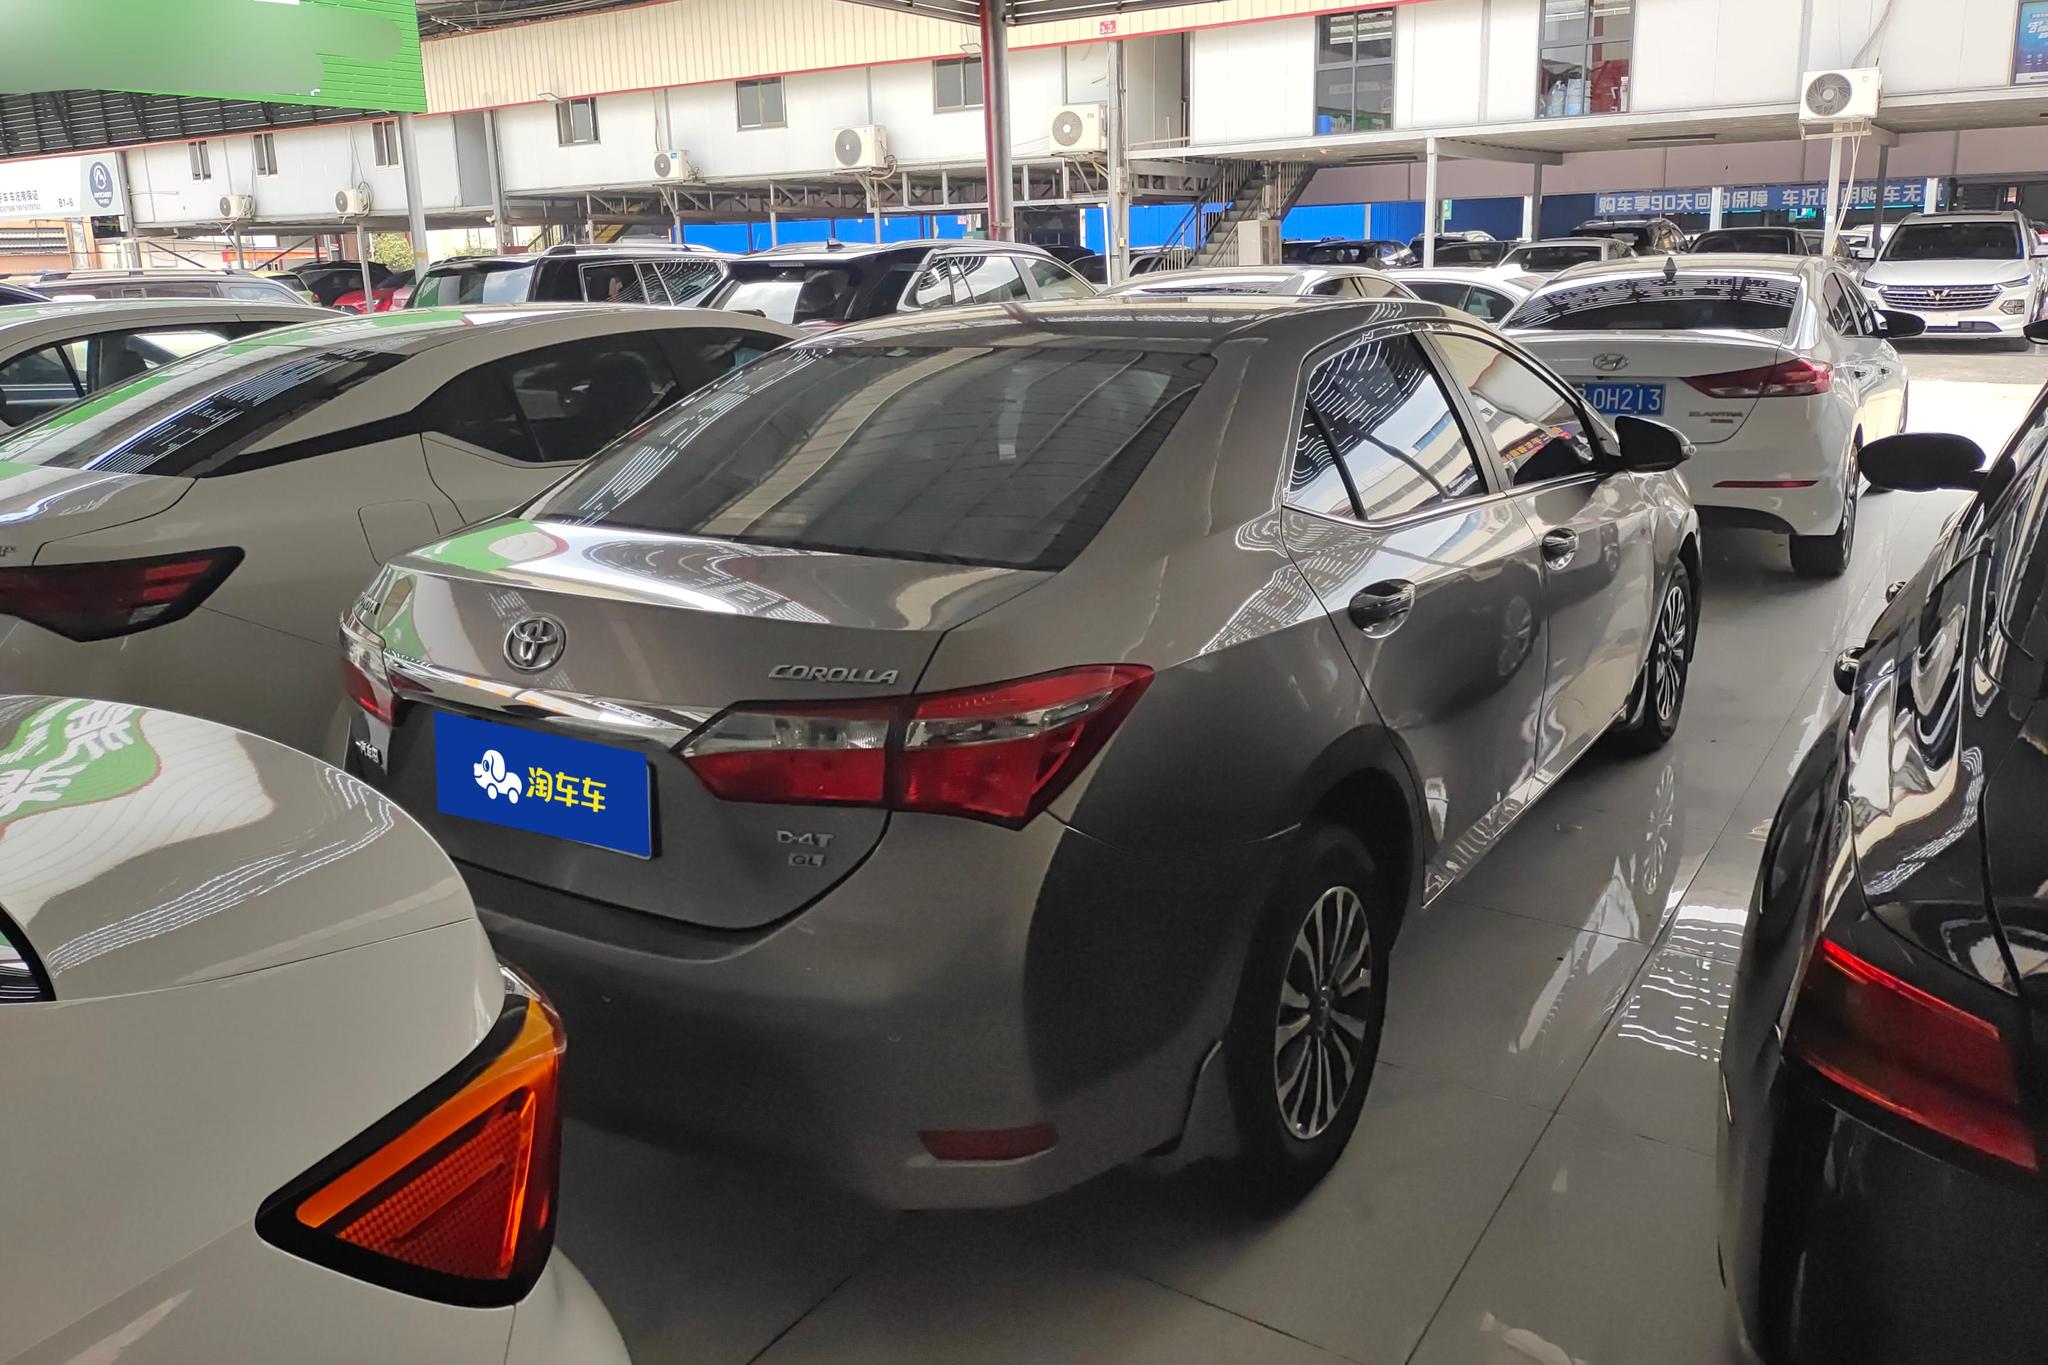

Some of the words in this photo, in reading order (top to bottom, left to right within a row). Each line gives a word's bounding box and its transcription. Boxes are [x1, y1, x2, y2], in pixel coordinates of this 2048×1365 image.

[1782, 183, 1943, 206] 车况明购车无
[768, 664, 899, 685] COROLLA
[790, 854, 823, 867] GL
